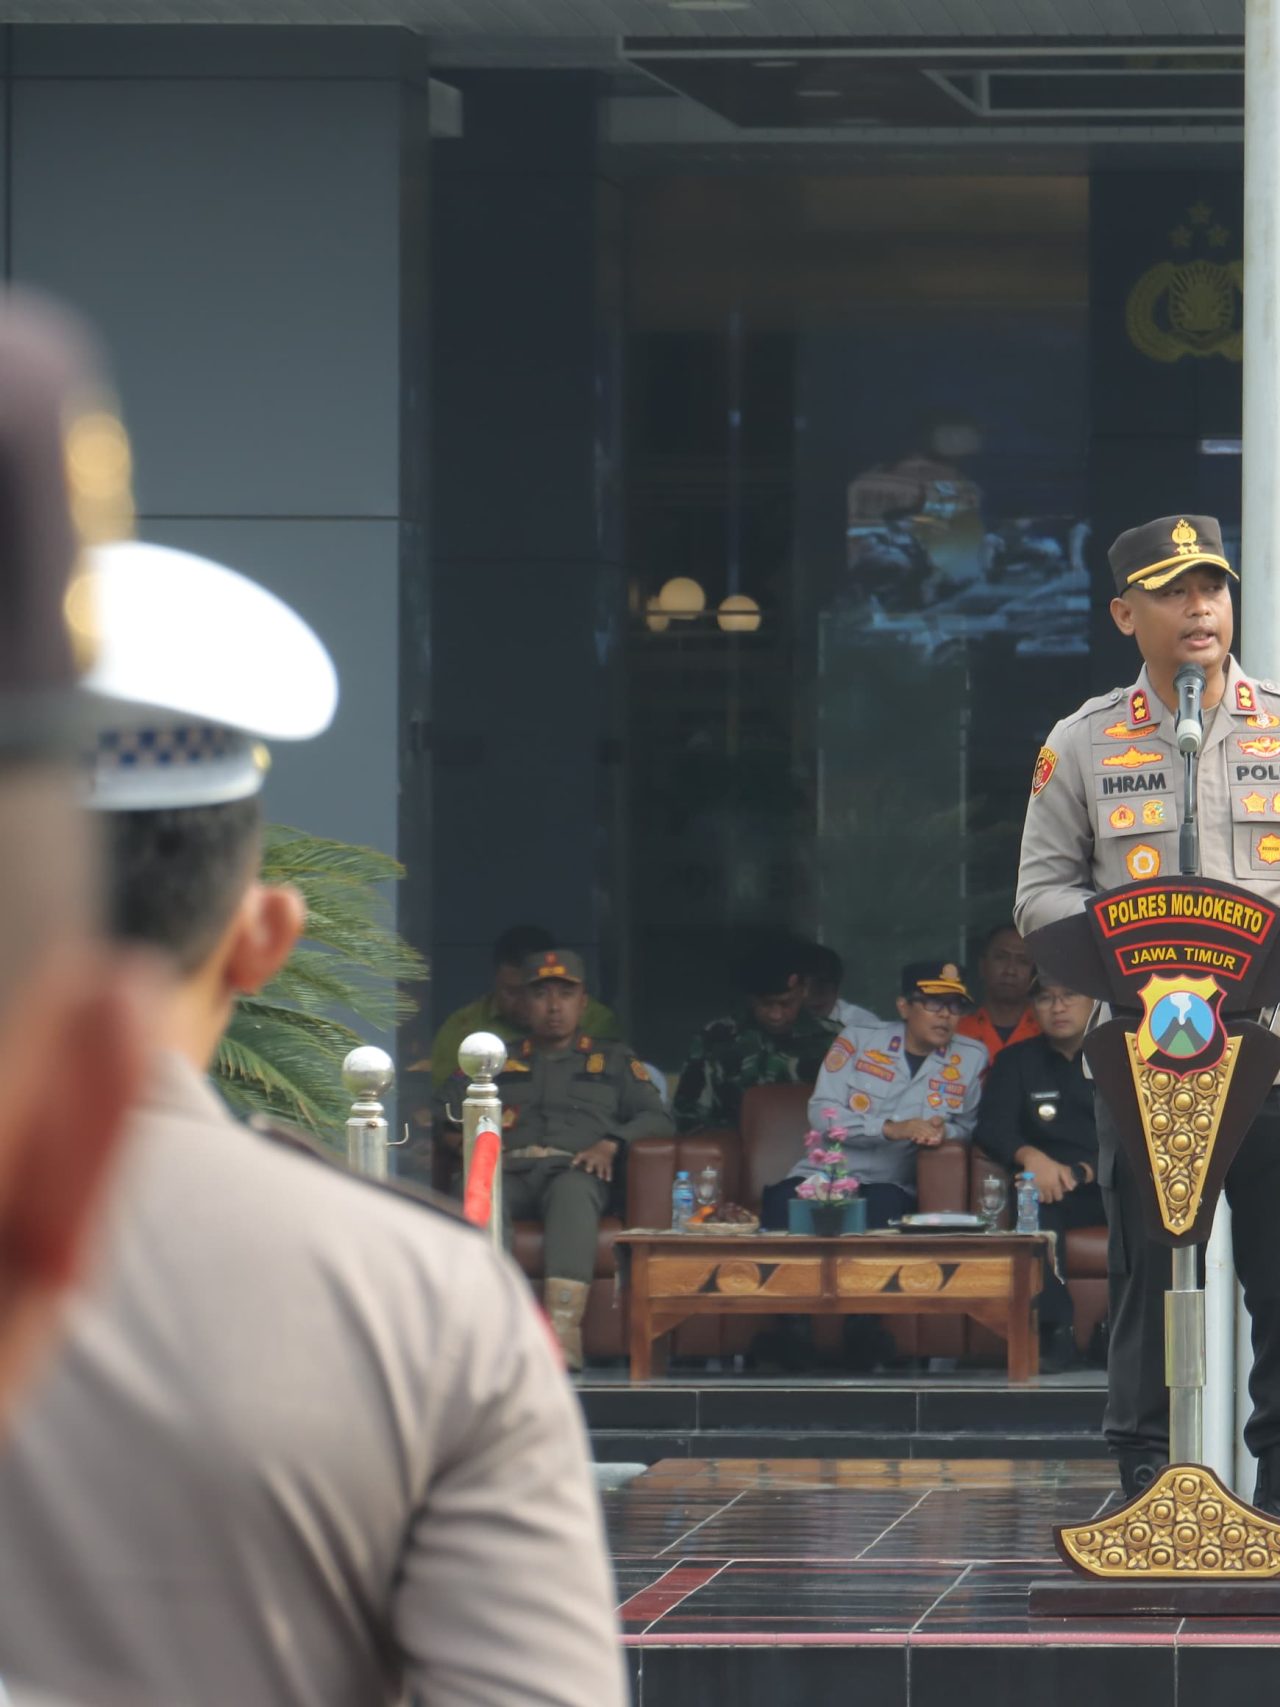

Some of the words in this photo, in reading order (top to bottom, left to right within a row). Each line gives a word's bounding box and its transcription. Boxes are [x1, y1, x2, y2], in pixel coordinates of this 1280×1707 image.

[1102, 772, 1167, 794] IHRAM
[1107, 894, 1167, 927] POLRES
[1171, 893, 1263, 934] MOJOKERTO
[1130, 948, 1177, 965] JAWA
[1184, 947, 1236, 970] TIMUR
